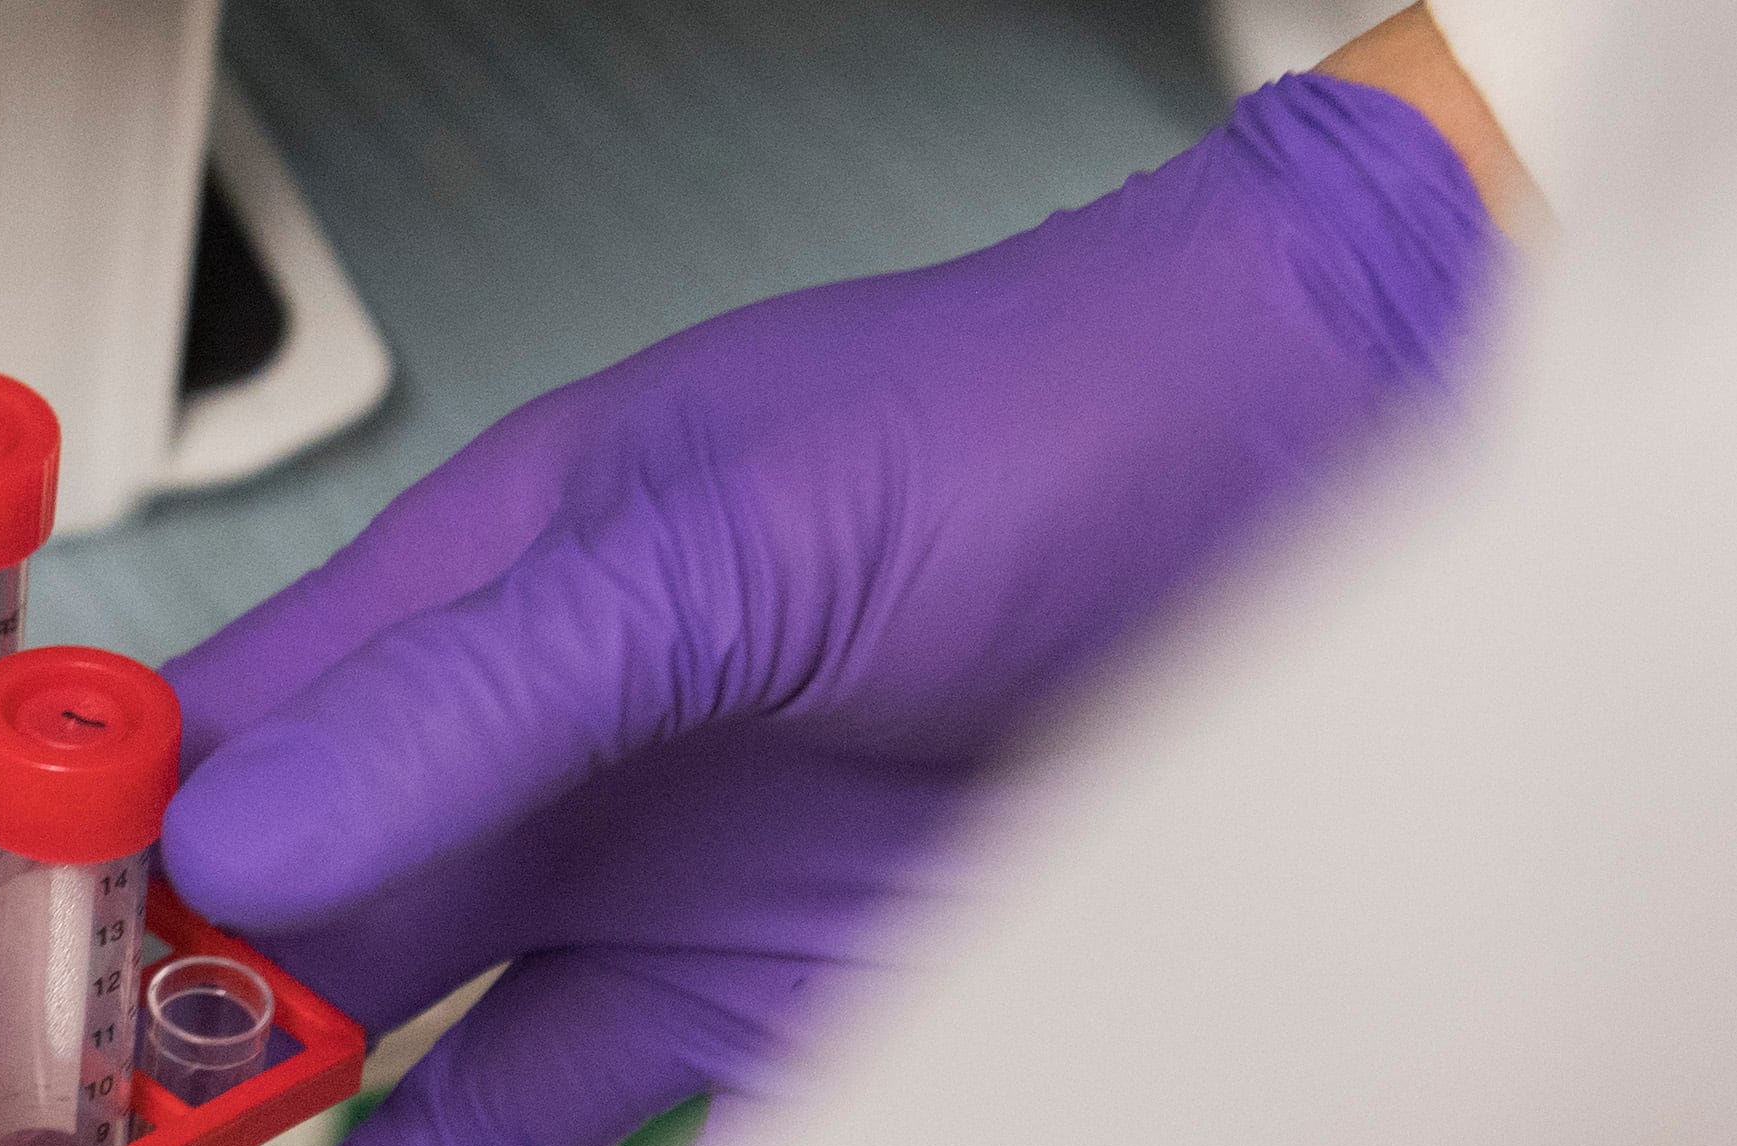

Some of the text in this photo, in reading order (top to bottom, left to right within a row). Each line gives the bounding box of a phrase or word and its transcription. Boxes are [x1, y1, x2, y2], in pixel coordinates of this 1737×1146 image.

[99, 868, 128, 897] 14
[96, 919, 124, 947] 13
[92, 970, 121, 998] 12
[91, 1023, 115, 1050] 11
[84, 1074, 114, 1102] 10
[95, 1121, 111, 1144] 9
